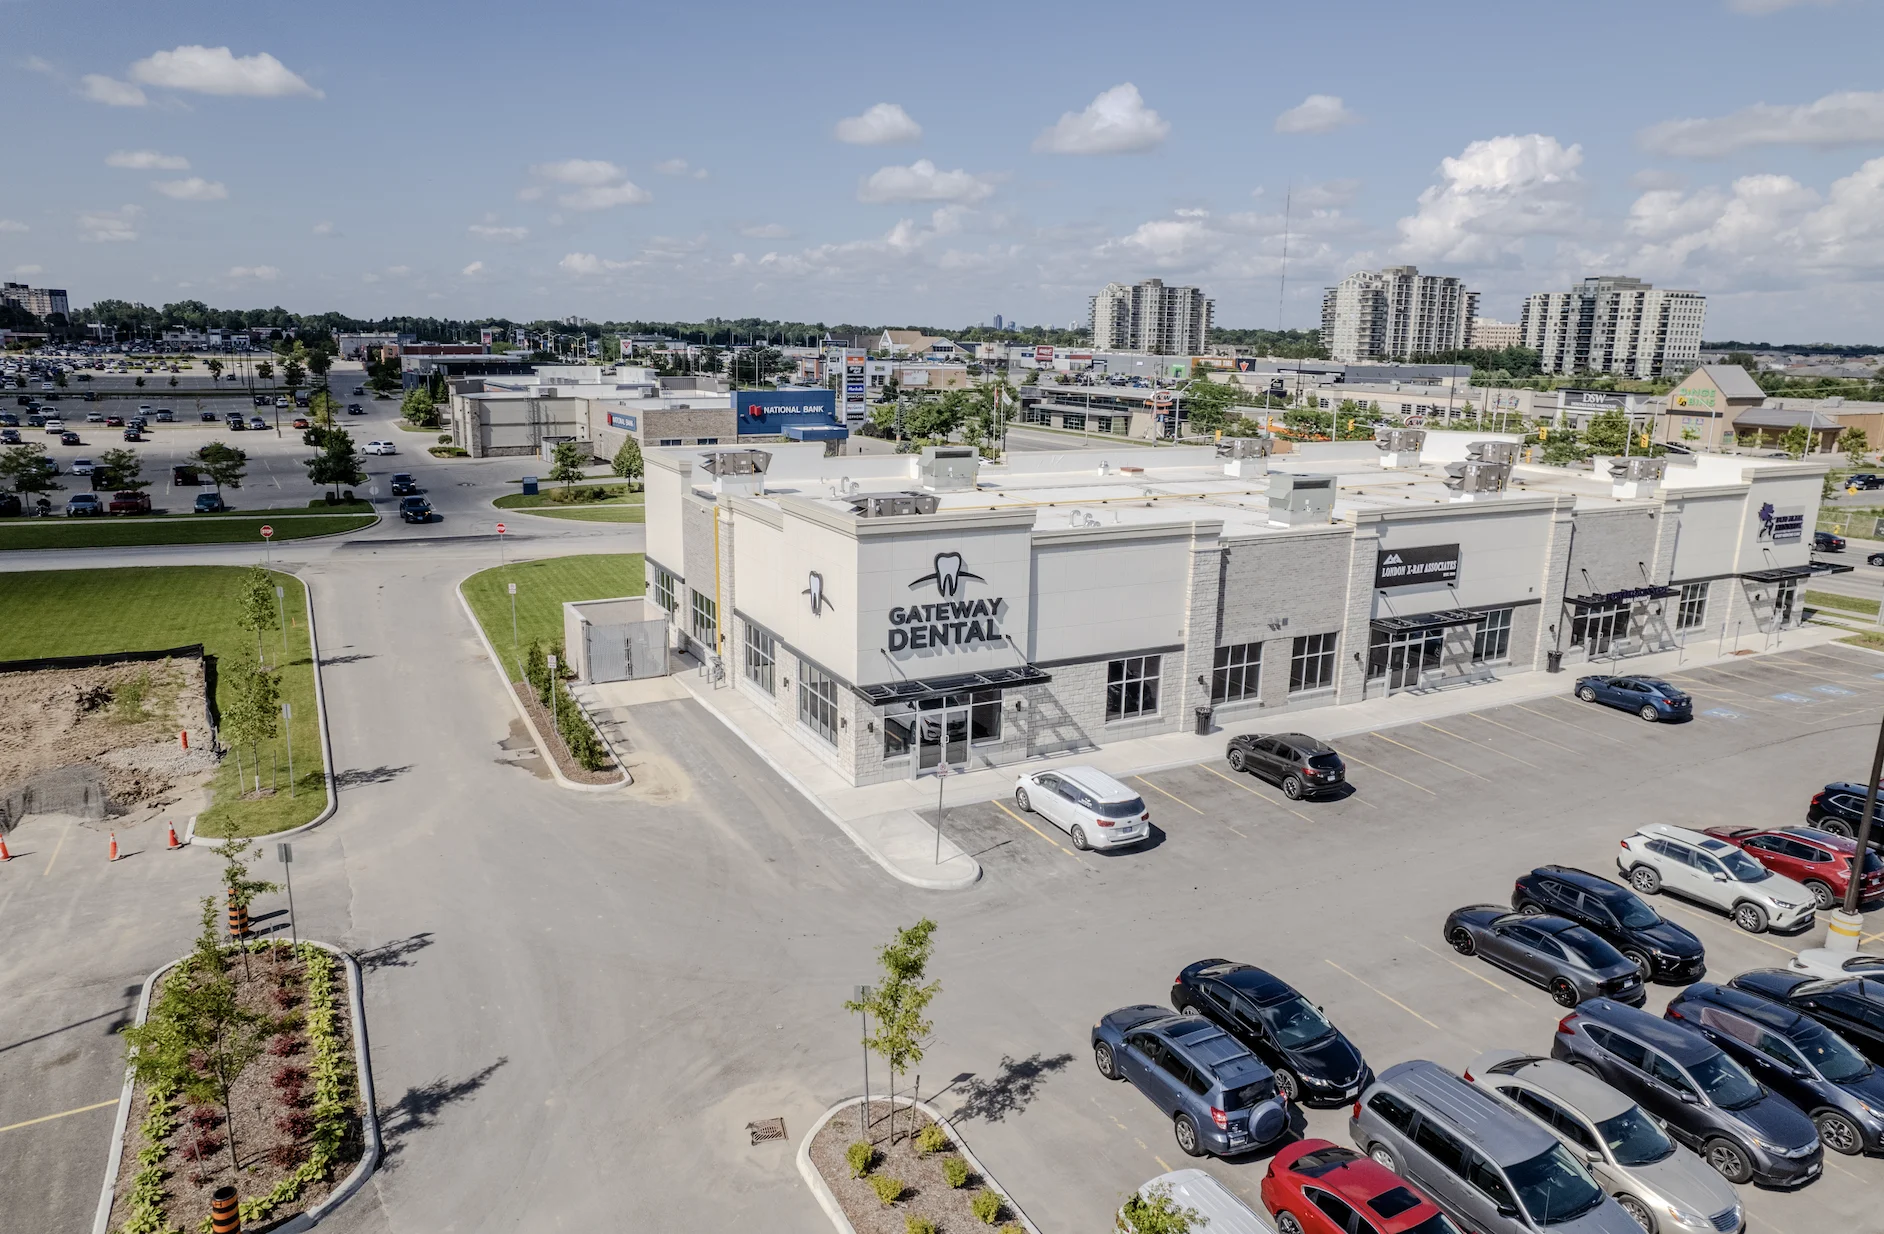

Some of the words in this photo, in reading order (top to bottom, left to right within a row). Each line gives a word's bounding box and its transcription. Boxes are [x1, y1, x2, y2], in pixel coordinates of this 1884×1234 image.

[1582, 393, 1606, 403] DSW
[763, 406, 801, 414] NATIONAL
[803, 405, 824, 413] BANK
[1381, 565, 1406, 578] LONDON
[1406, 563, 1425, 575] X-RAY
[1424, 560, 1457, 573] ASSOCIATES
[888, 597, 1003, 625] GATEWAY
[888, 619, 1002, 652] DENTAL
